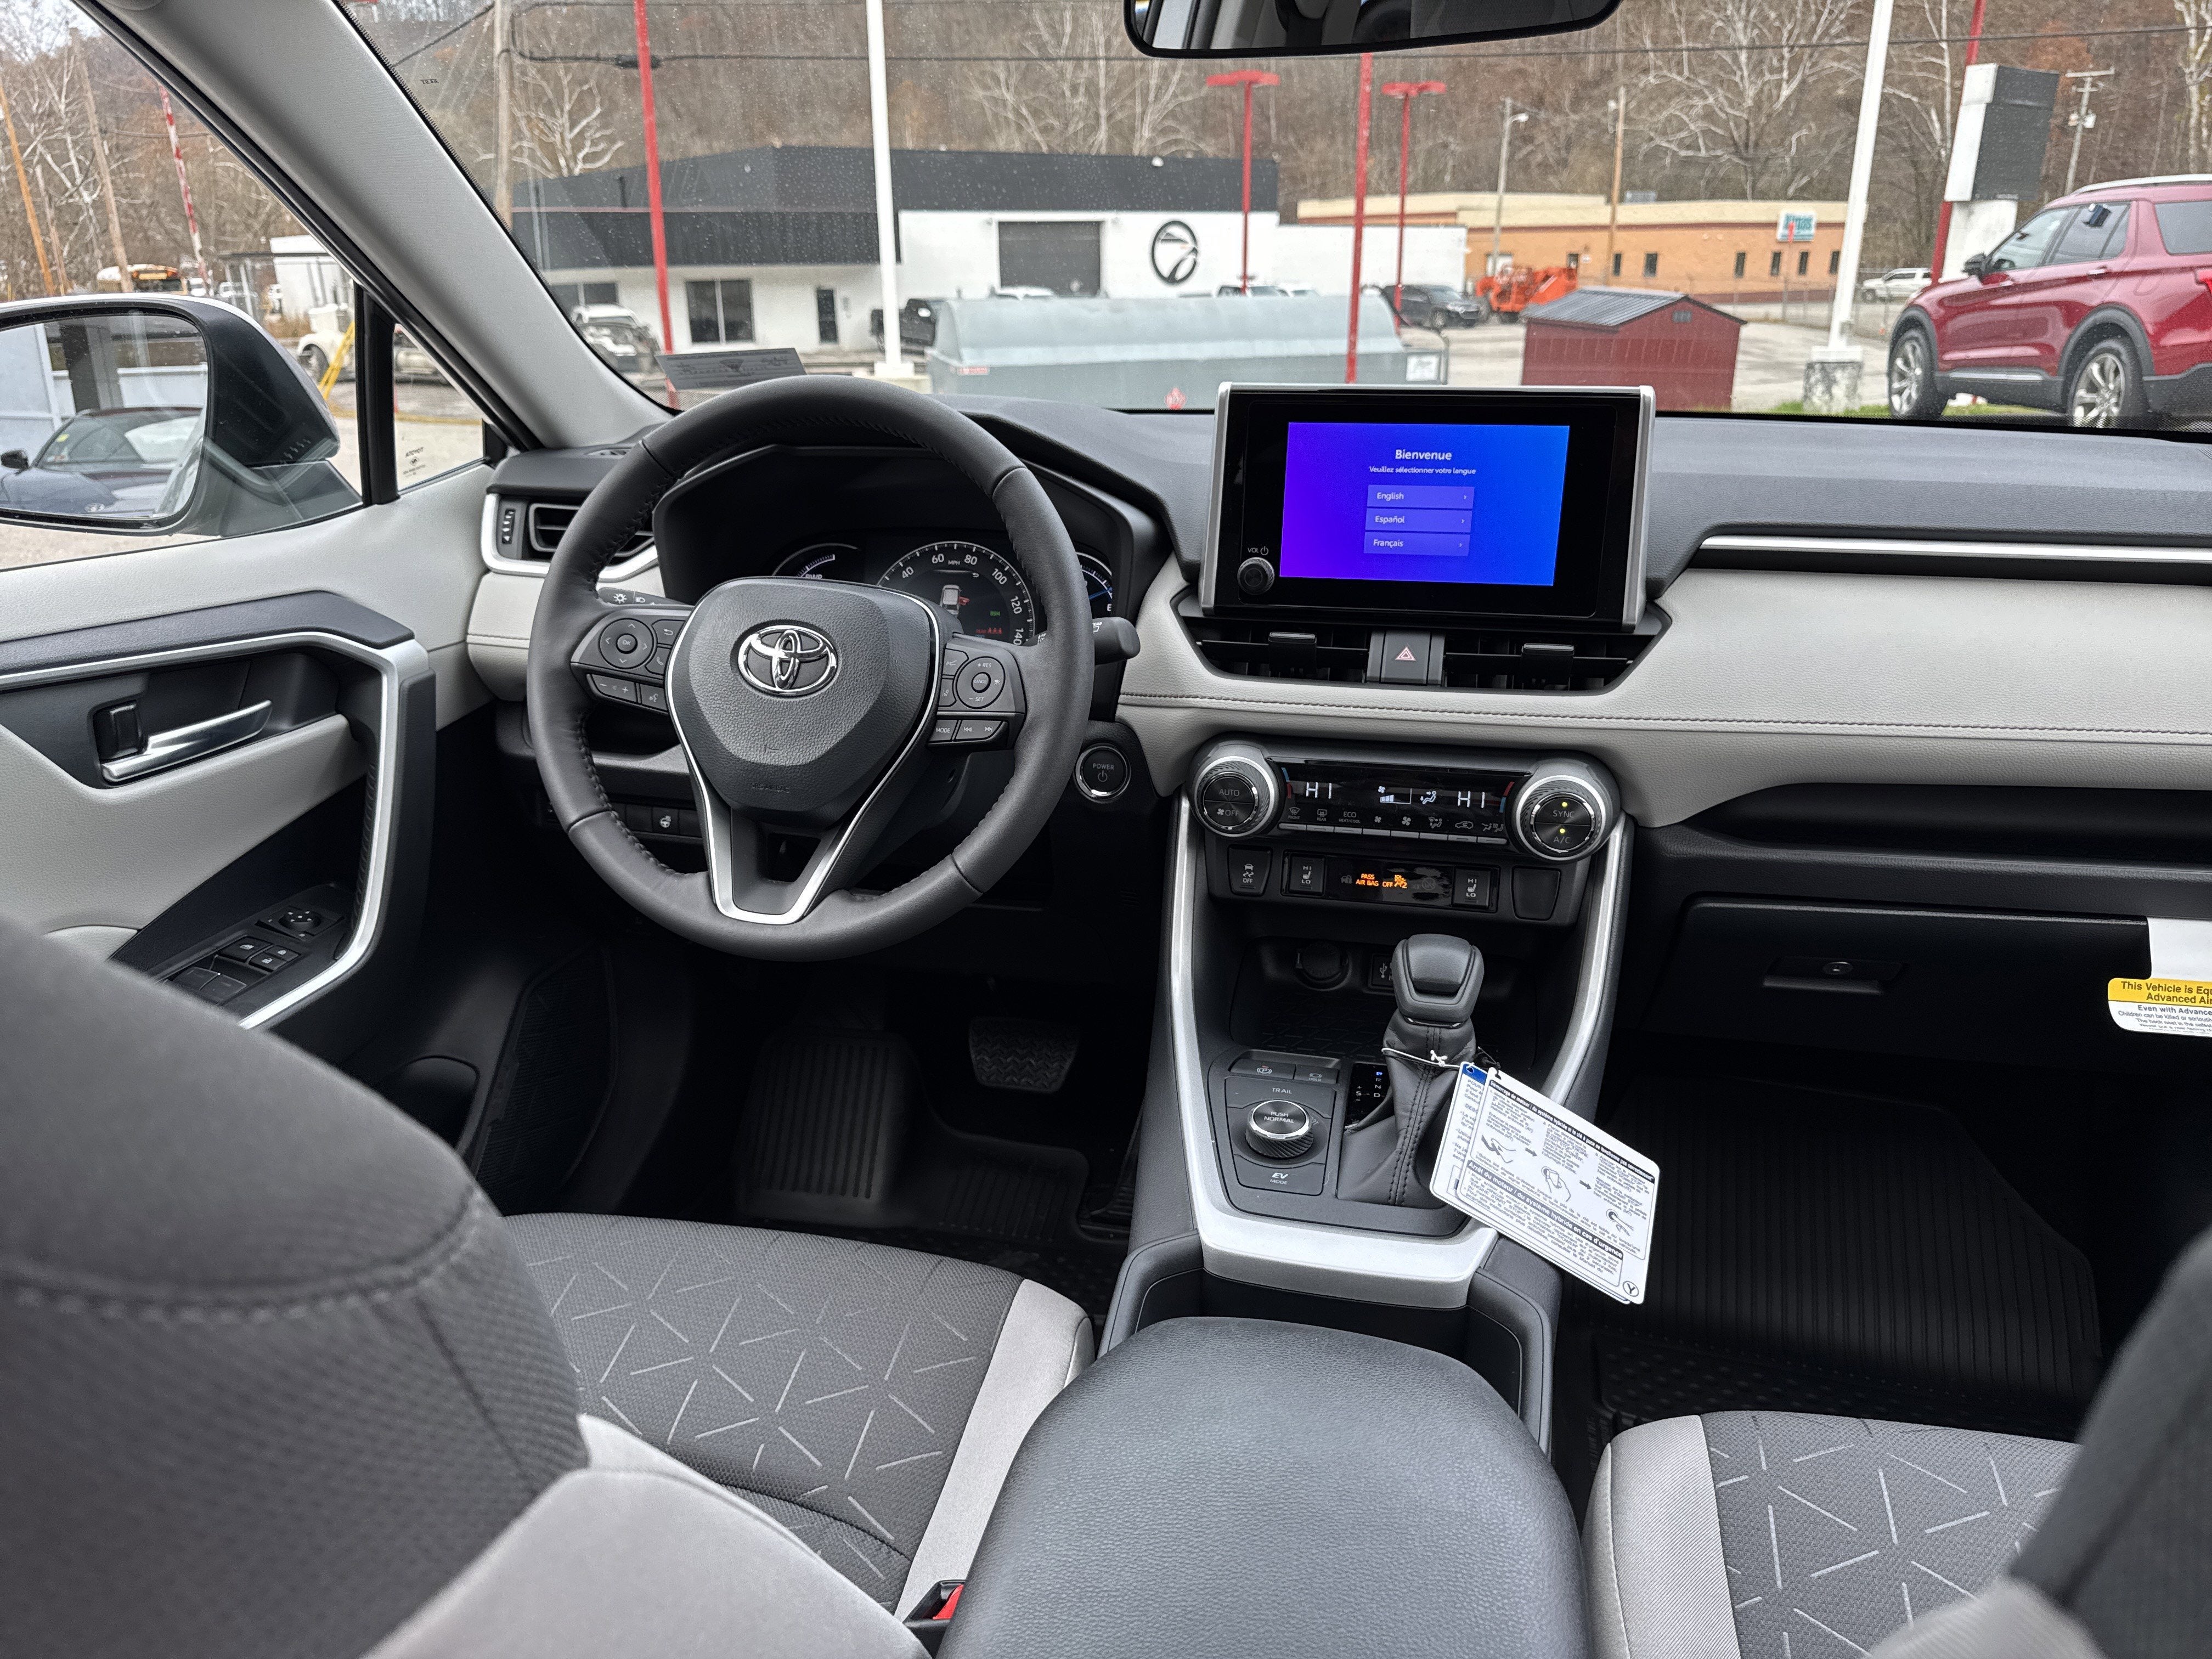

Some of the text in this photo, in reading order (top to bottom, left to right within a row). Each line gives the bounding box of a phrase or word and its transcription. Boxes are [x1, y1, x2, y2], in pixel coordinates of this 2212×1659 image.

[1395, 449, 1453, 461] Bienvenue
[1395, 466, 1435, 475] sélectionner
[1453, 467, 1476, 476] langue
[1376, 492, 1404, 501] English
[1375, 515, 1405, 524] Español
[1373, 538, 1404, 549] Français
[932, 554, 945, 564] 60
[964, 554, 978, 565] 80
[901, 566, 914, 579] 40
[991, 568, 1007, 585] 100
[1010, 596, 1023, 614] 120
[1107, 603, 1112, 612] E
[1013, 628, 1024, 645] 140
[1218, 788, 1240, 797] AUTO
[1306, 782, 1332, 799] HI
[1457, 791, 1485, 809] HI
[1553, 810, 1575, 819] SYNC
[1553, 836, 1571, 844] A/C
[2121, 981, 2142, 990] This
[2146, 983, 2181, 993] Vehicle
[2185, 985, 2193, 994] is
[2146, 992, 2196, 1003] Advanced
[1263, 1115, 1295, 1124] NORMAL
[1468, 1160, 1483, 1175] Arrêt
[1483, 1170, 1492, 1180] du
[1492, 1176, 1513, 1193] moteur
[1516, 1190, 1525, 1200] du
[1525, 1196, 1550, 1216] système
[1550, 1211, 1573, 1230] hybride
[1573, 1225, 1581, 1234] en
[1582, 1231, 1593, 1241] cas
[1593, 1237, 1622, 1260] d'urgence
[1626, 1282, 1635, 1296] Y
